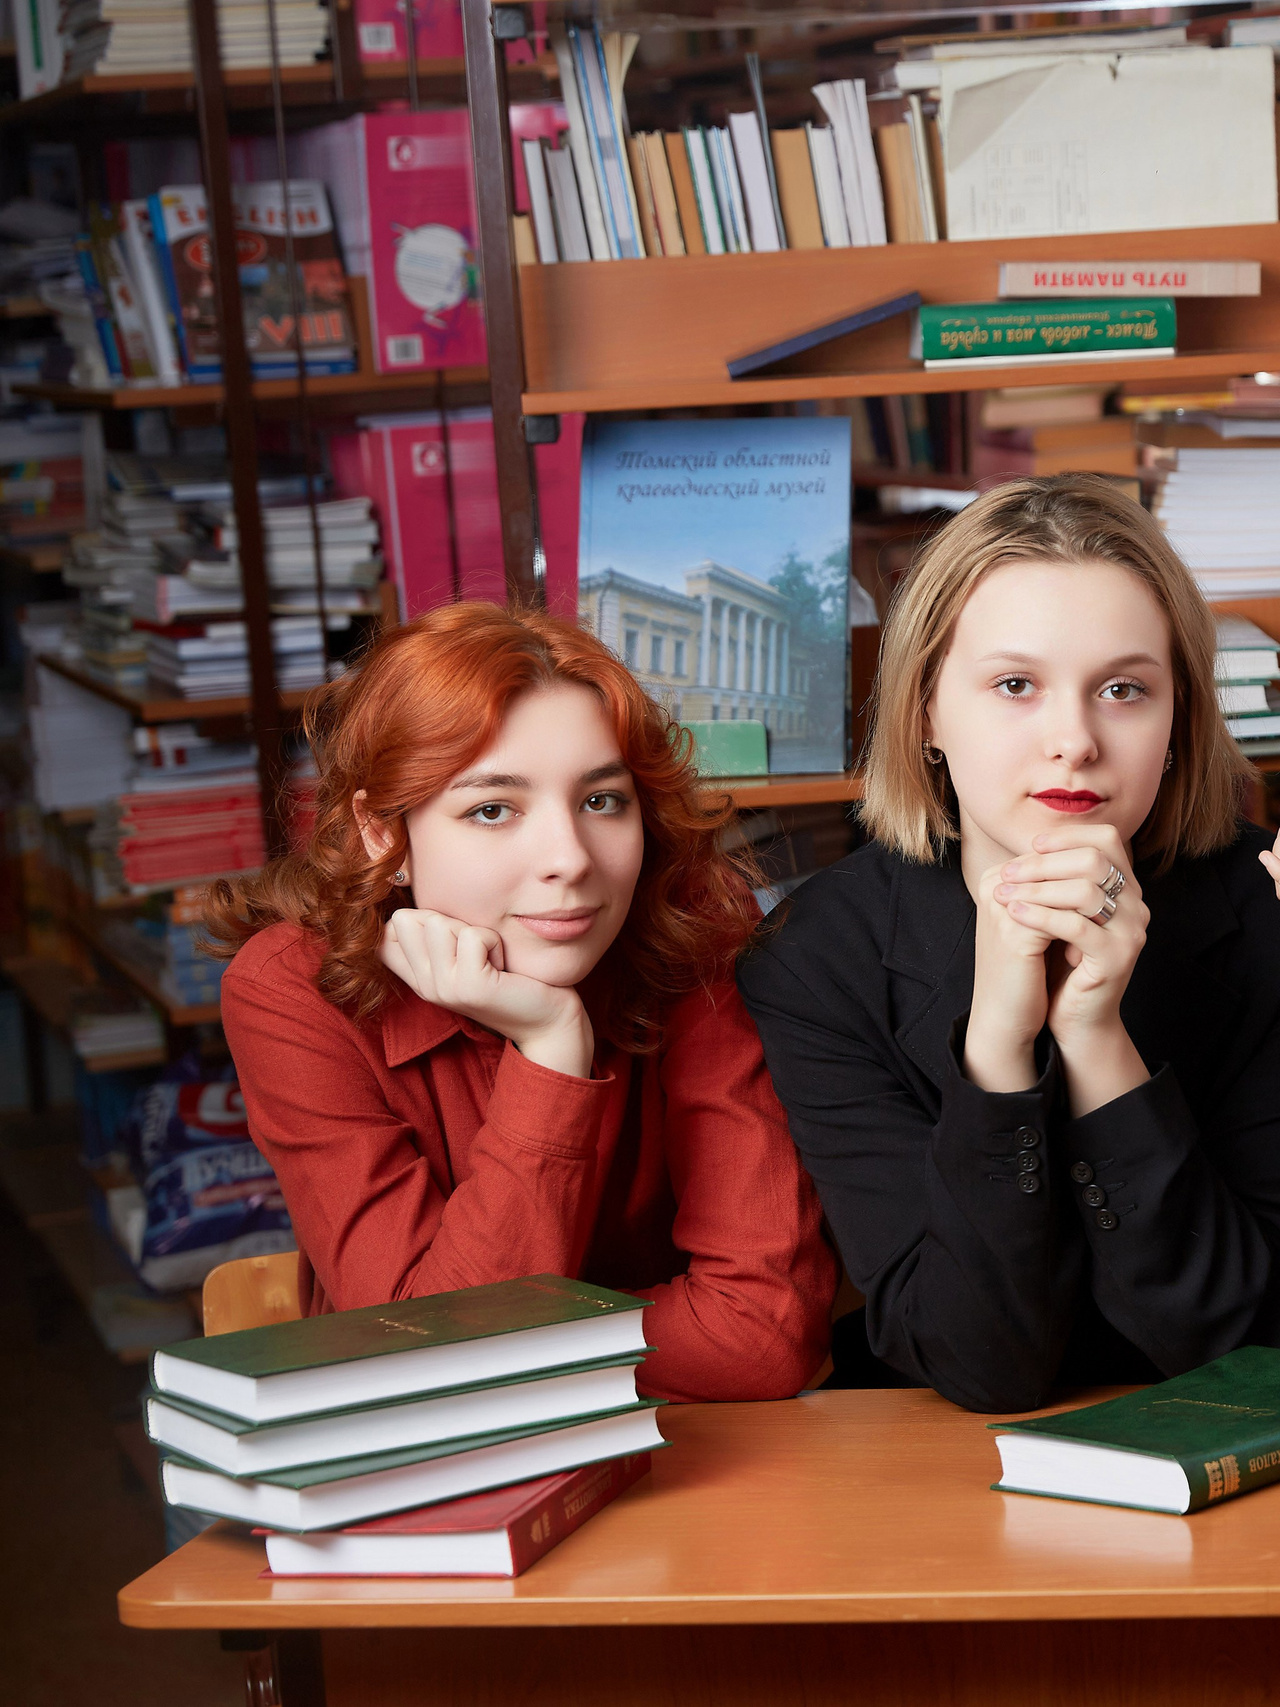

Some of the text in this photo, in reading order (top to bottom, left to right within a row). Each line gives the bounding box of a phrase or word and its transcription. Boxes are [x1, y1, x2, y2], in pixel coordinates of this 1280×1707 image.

[1032, 271, 1186, 288] ПУТЬ ПАМЯТИ
[259, 312, 344, 345] VIII
[940, 322, 988, 351] судьба
[992, 329, 1002, 343] и
[1007, 328, 1036, 343] моя
[1040, 325, 1091, 346] любовь
[1106, 317, 1158, 340] Томск
[615, 447, 831, 471] Томский областной
[616, 477, 826, 503] краеведческий музей
